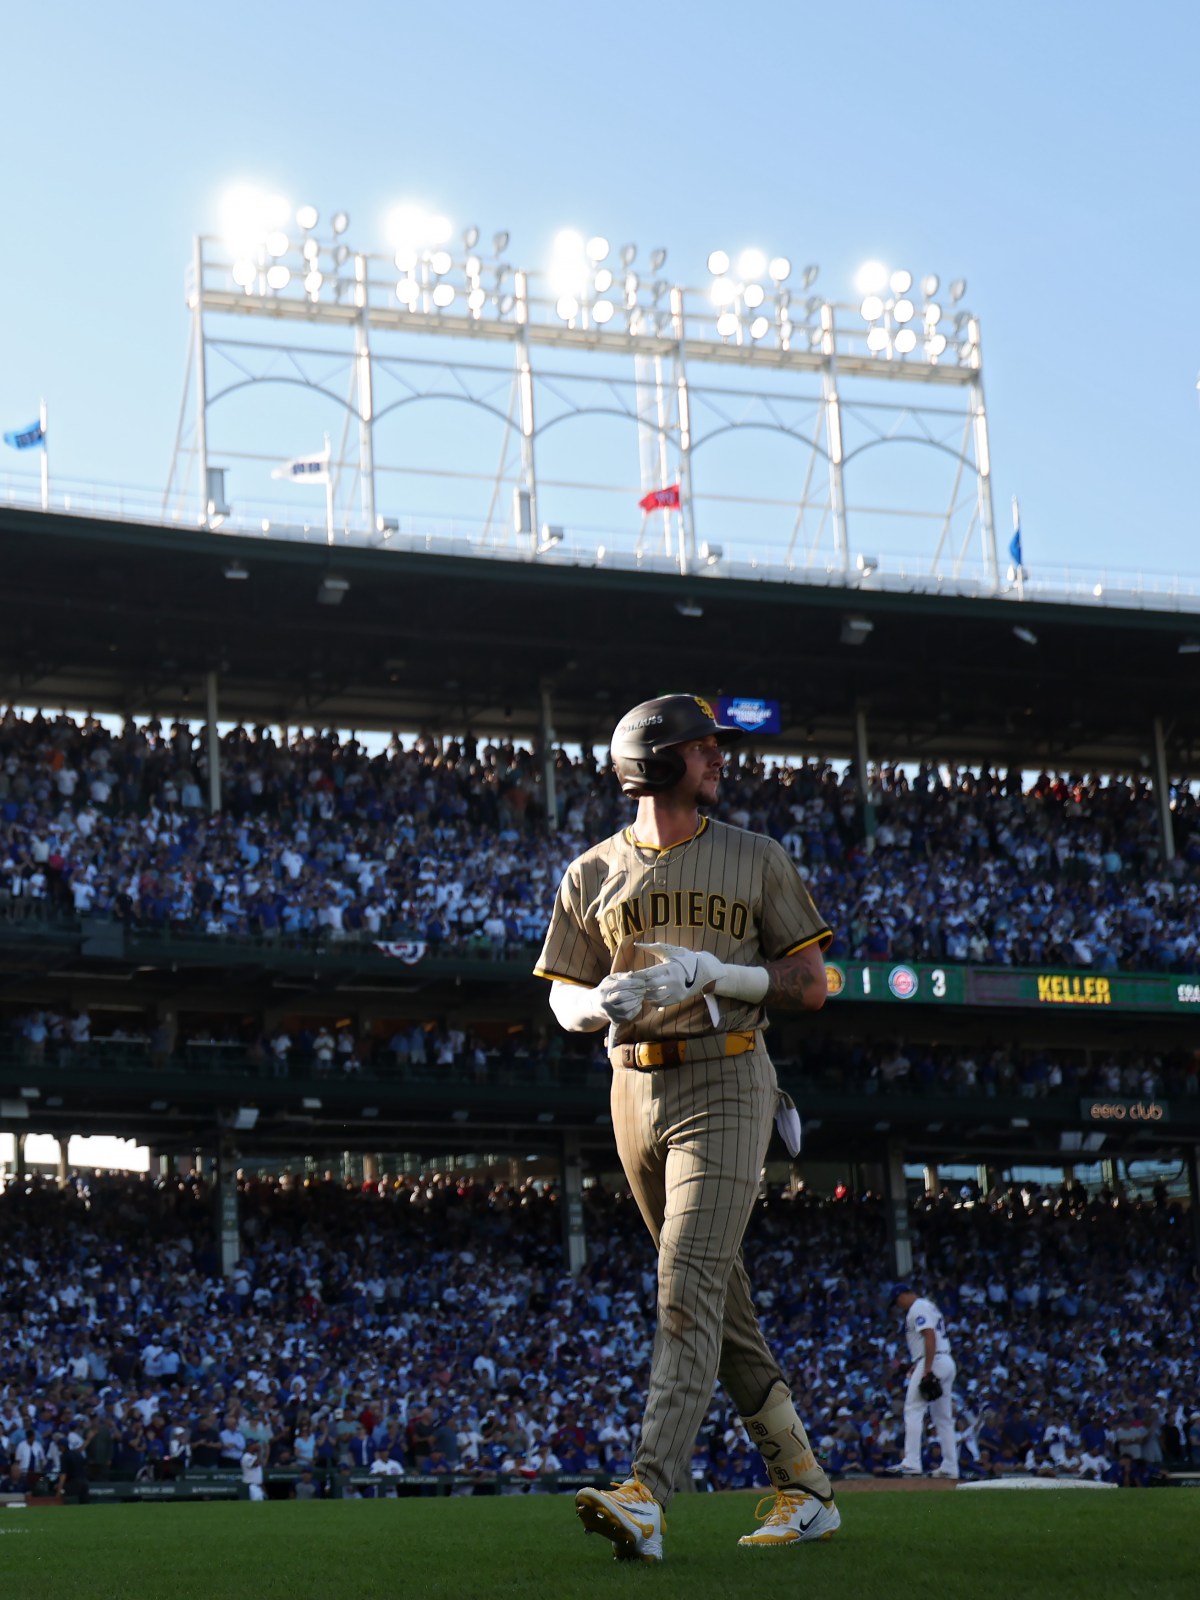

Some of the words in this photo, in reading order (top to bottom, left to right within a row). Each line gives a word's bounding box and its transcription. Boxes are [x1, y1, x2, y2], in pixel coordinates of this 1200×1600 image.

[649, 890, 749, 941] DIEGO
[931, 968, 946, 997] 3
[1037, 974, 1111, 1004] KELLER
[1129, 1101, 1163, 1120] club
